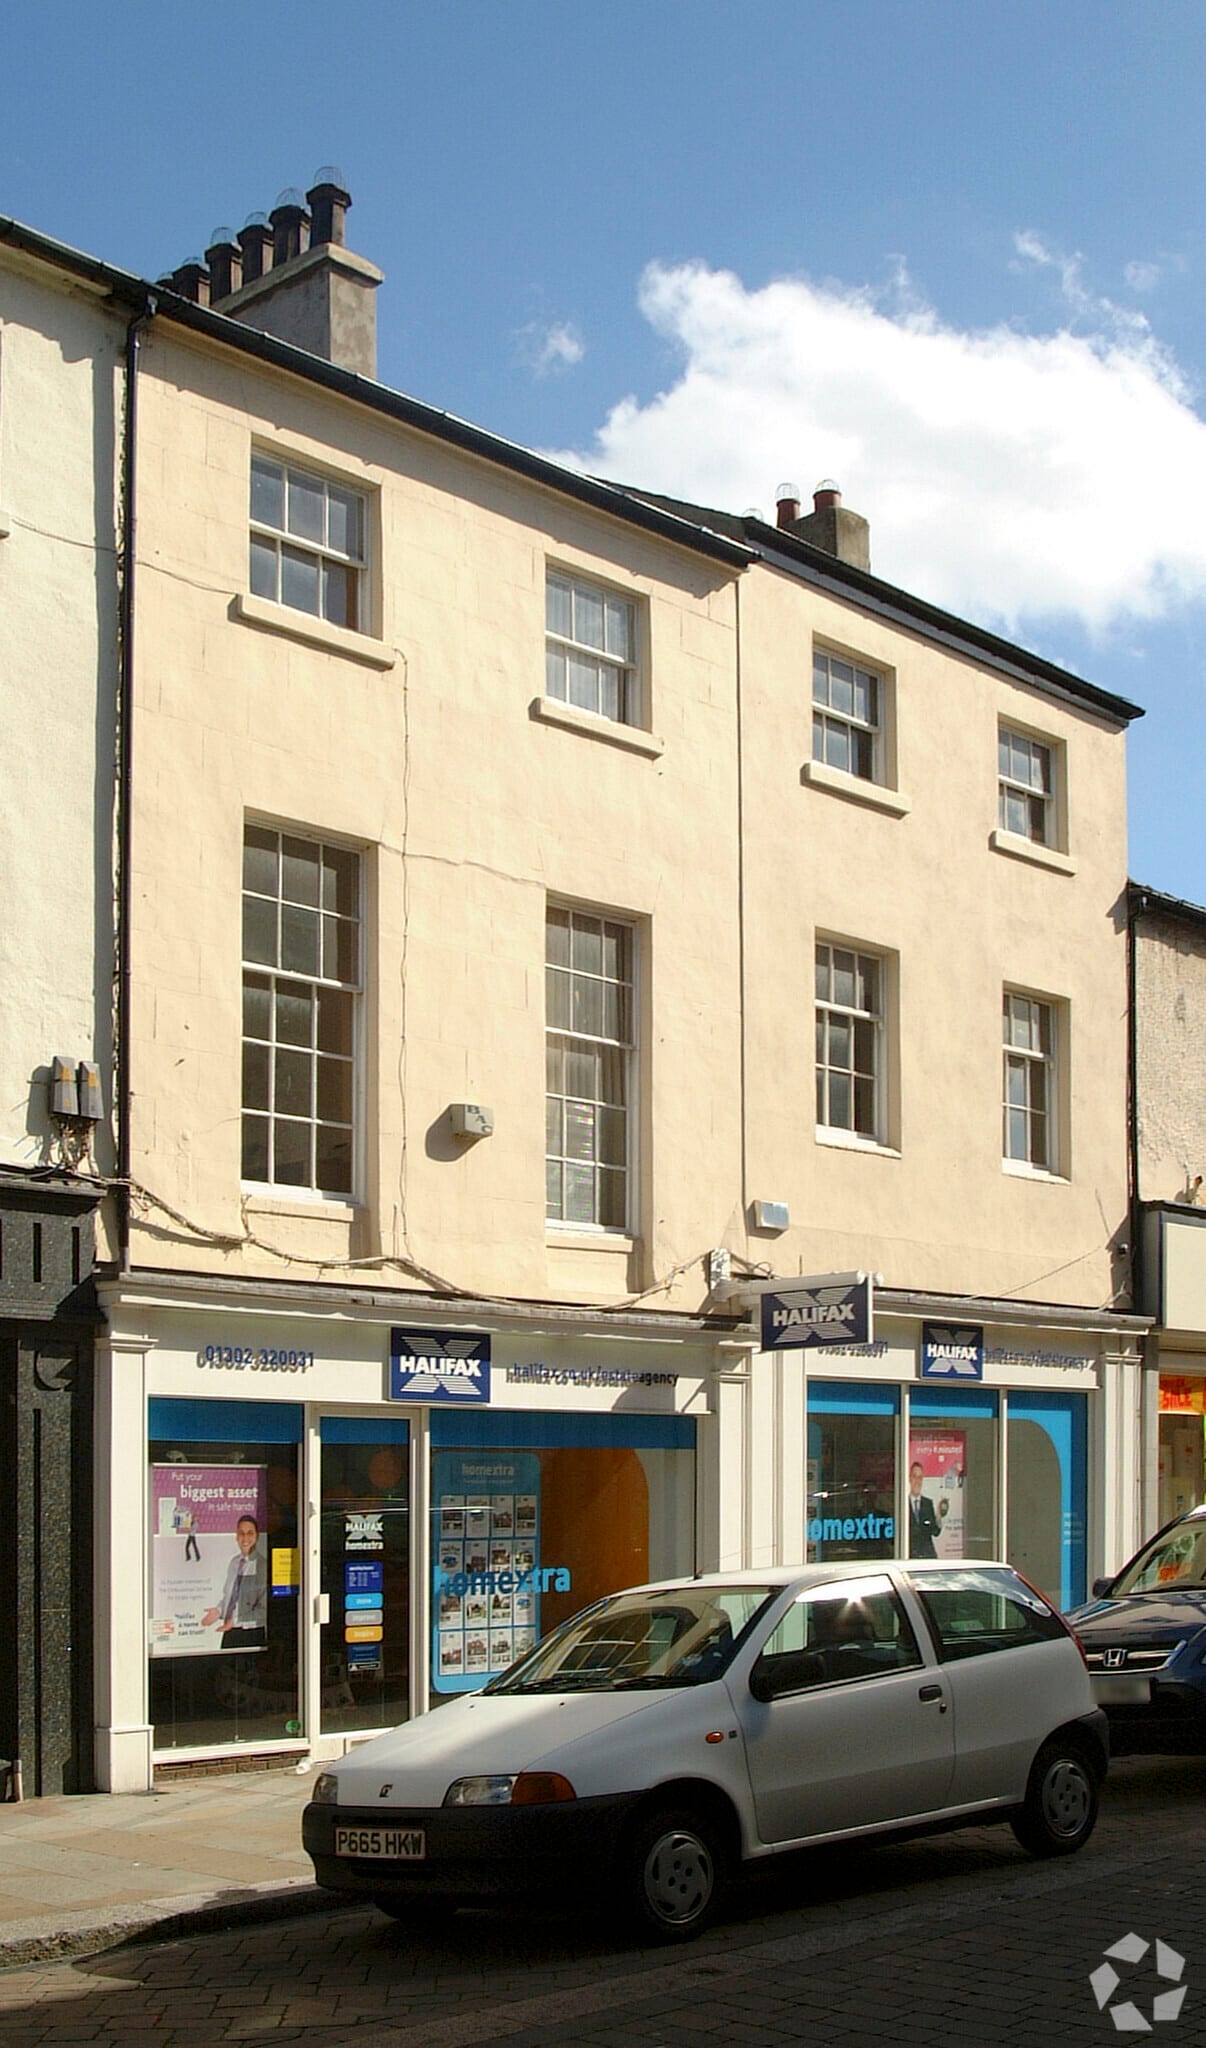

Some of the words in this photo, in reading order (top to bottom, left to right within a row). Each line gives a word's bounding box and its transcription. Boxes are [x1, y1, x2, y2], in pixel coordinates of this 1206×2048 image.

[773, 1303, 855, 1327] HALIFAX
[205, 1345, 253, 1364] 01302
[260, 1348, 314, 1367] 320031
[927, 1343, 978, 1361] HALIFAX
[400, 1355, 482, 1377] HALIFAX
[180, 1484, 225, 1502] biggest
[227, 1486, 258, 1498] asset
[216, 1502, 232, 1512] safe
[233, 1502, 255, 1512] hands
[807, 1513, 895, 1542] omextra
[433, 1565, 571, 1596] homextra
[338, 1831, 382, 1853] P665
[385, 1833, 422, 1855] HKW
